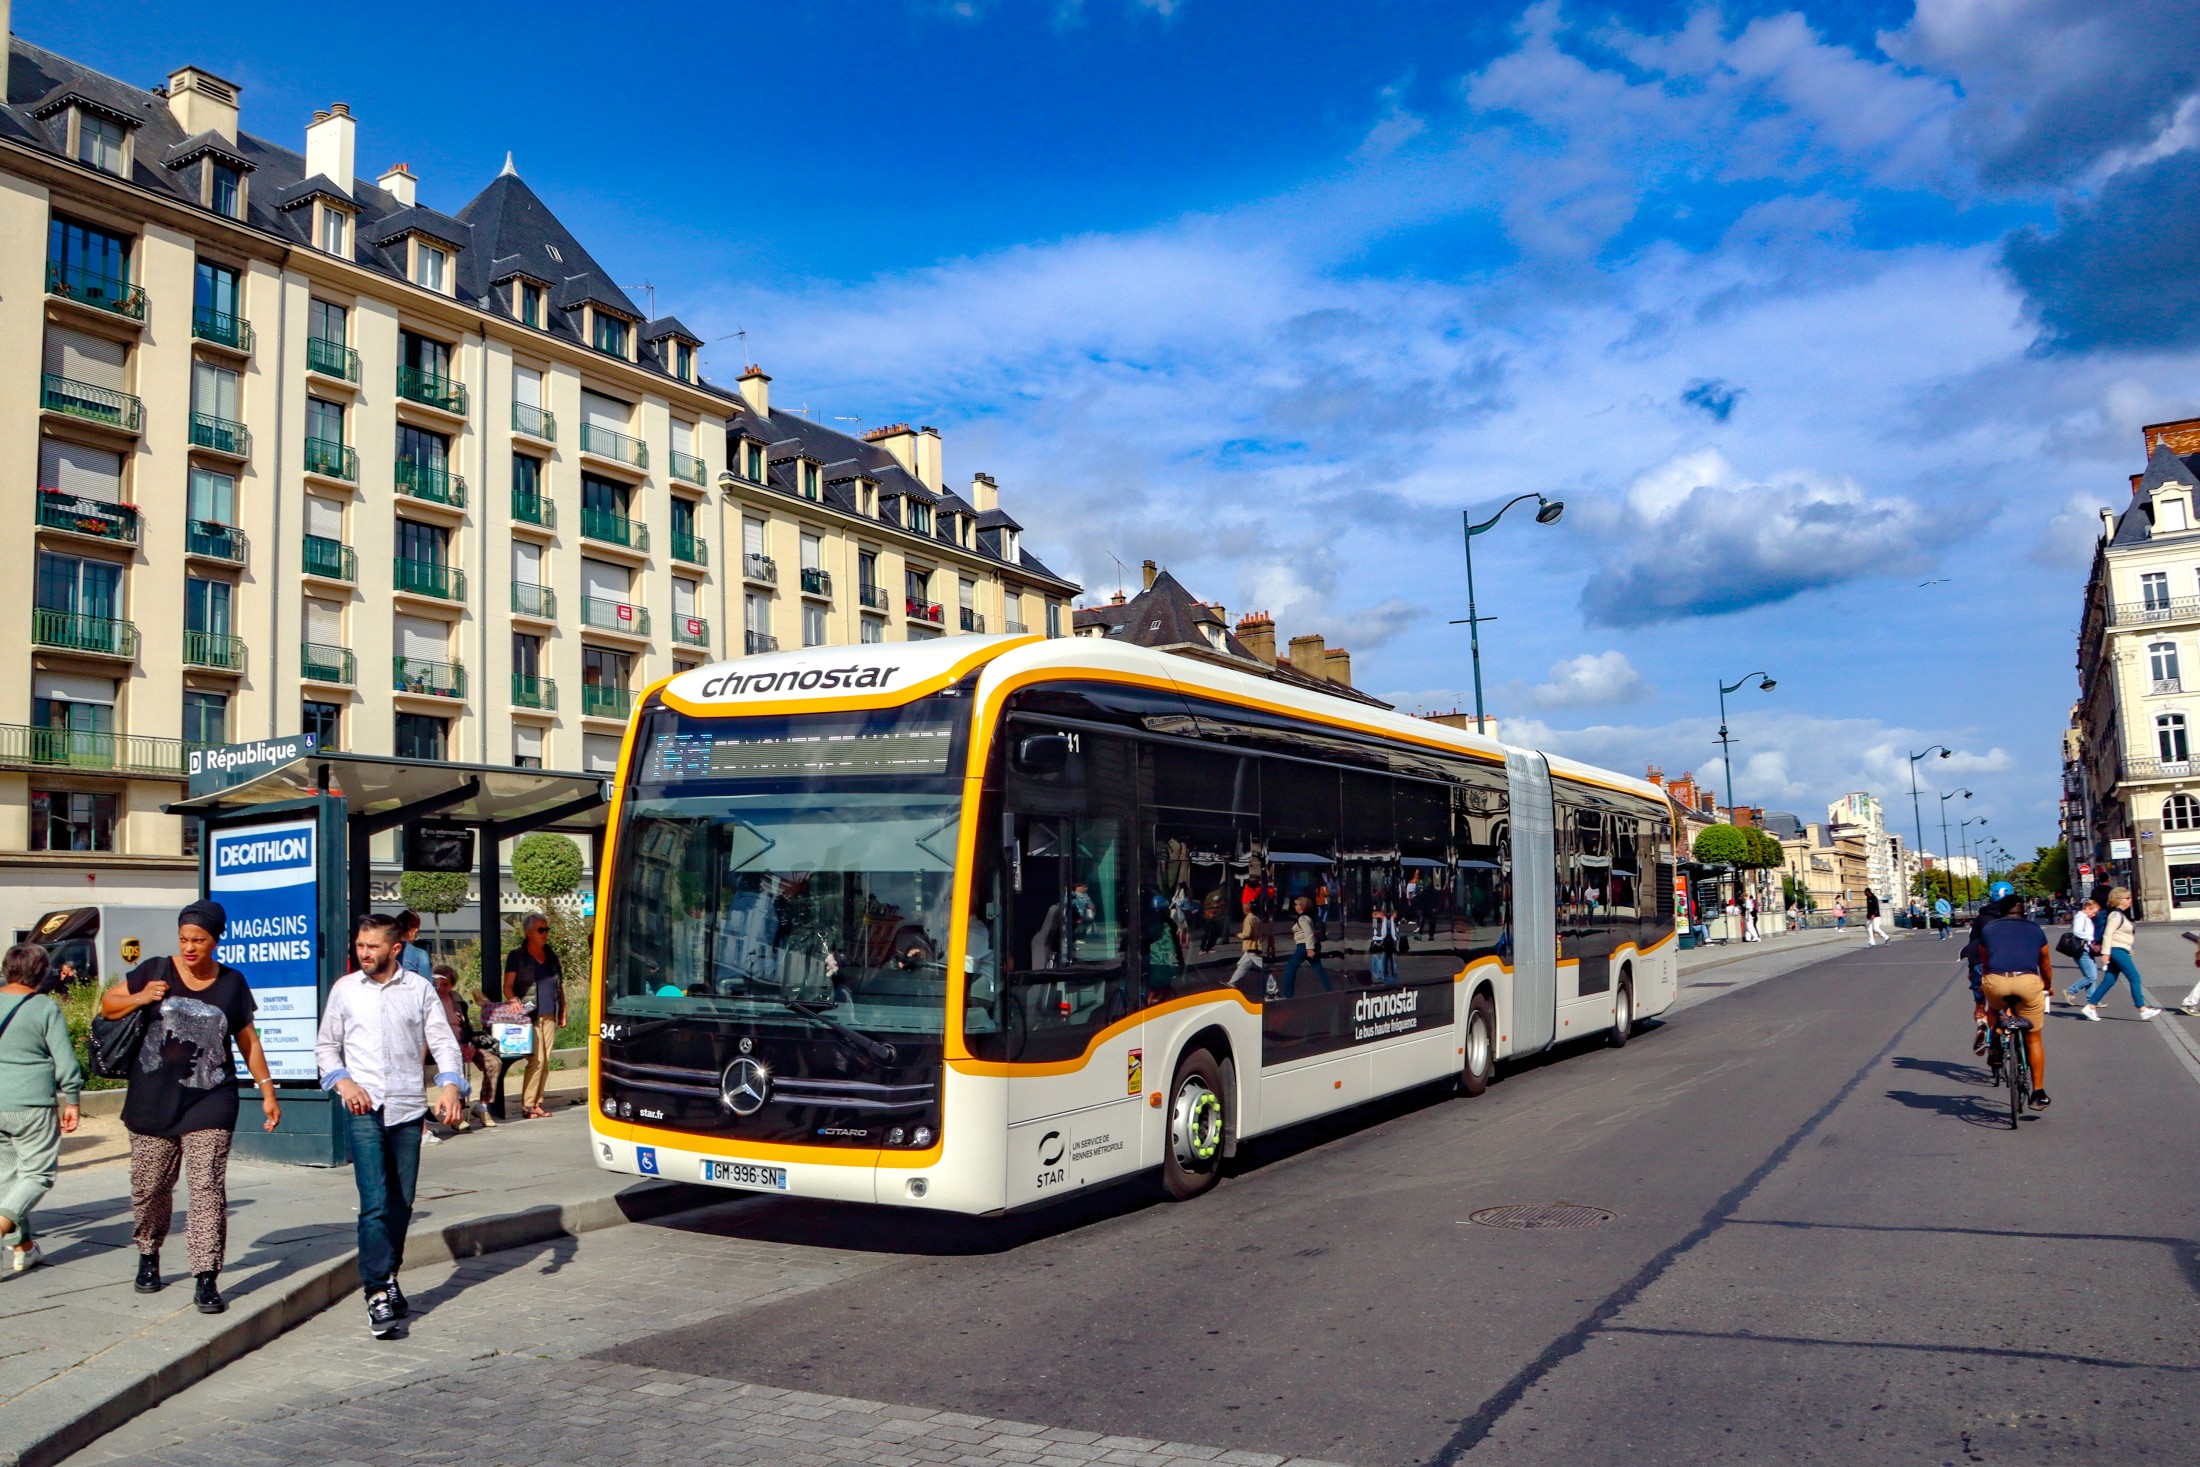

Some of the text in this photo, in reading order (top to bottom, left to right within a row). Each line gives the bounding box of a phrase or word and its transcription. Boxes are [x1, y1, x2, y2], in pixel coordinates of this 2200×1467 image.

[701, 664, 901, 698] chronostar
[206, 742, 297, 772] République
[220, 837, 307, 868] DECATHLON
[231, 915, 308, 939] MAGASINS
[122, 945, 140, 960] ups
[216, 940, 311, 964] SUR RENNES
[1355, 987, 1419, 1022] chronostar
[1355, 1017, 1417, 1040] Le bus haute fréquence
[639, 1108, 664, 1120] star.fr
[817, 1128, 868, 1137] eCITARO
[1072, 1134, 1109, 1150] UN SERVICE DE
[1072, 1141, 1123, 1161] RENNES MÉTROPOLE
[714, 1163, 778, 1186] GM-996-SN
[1037, 1168, 1064, 1188] STAR
